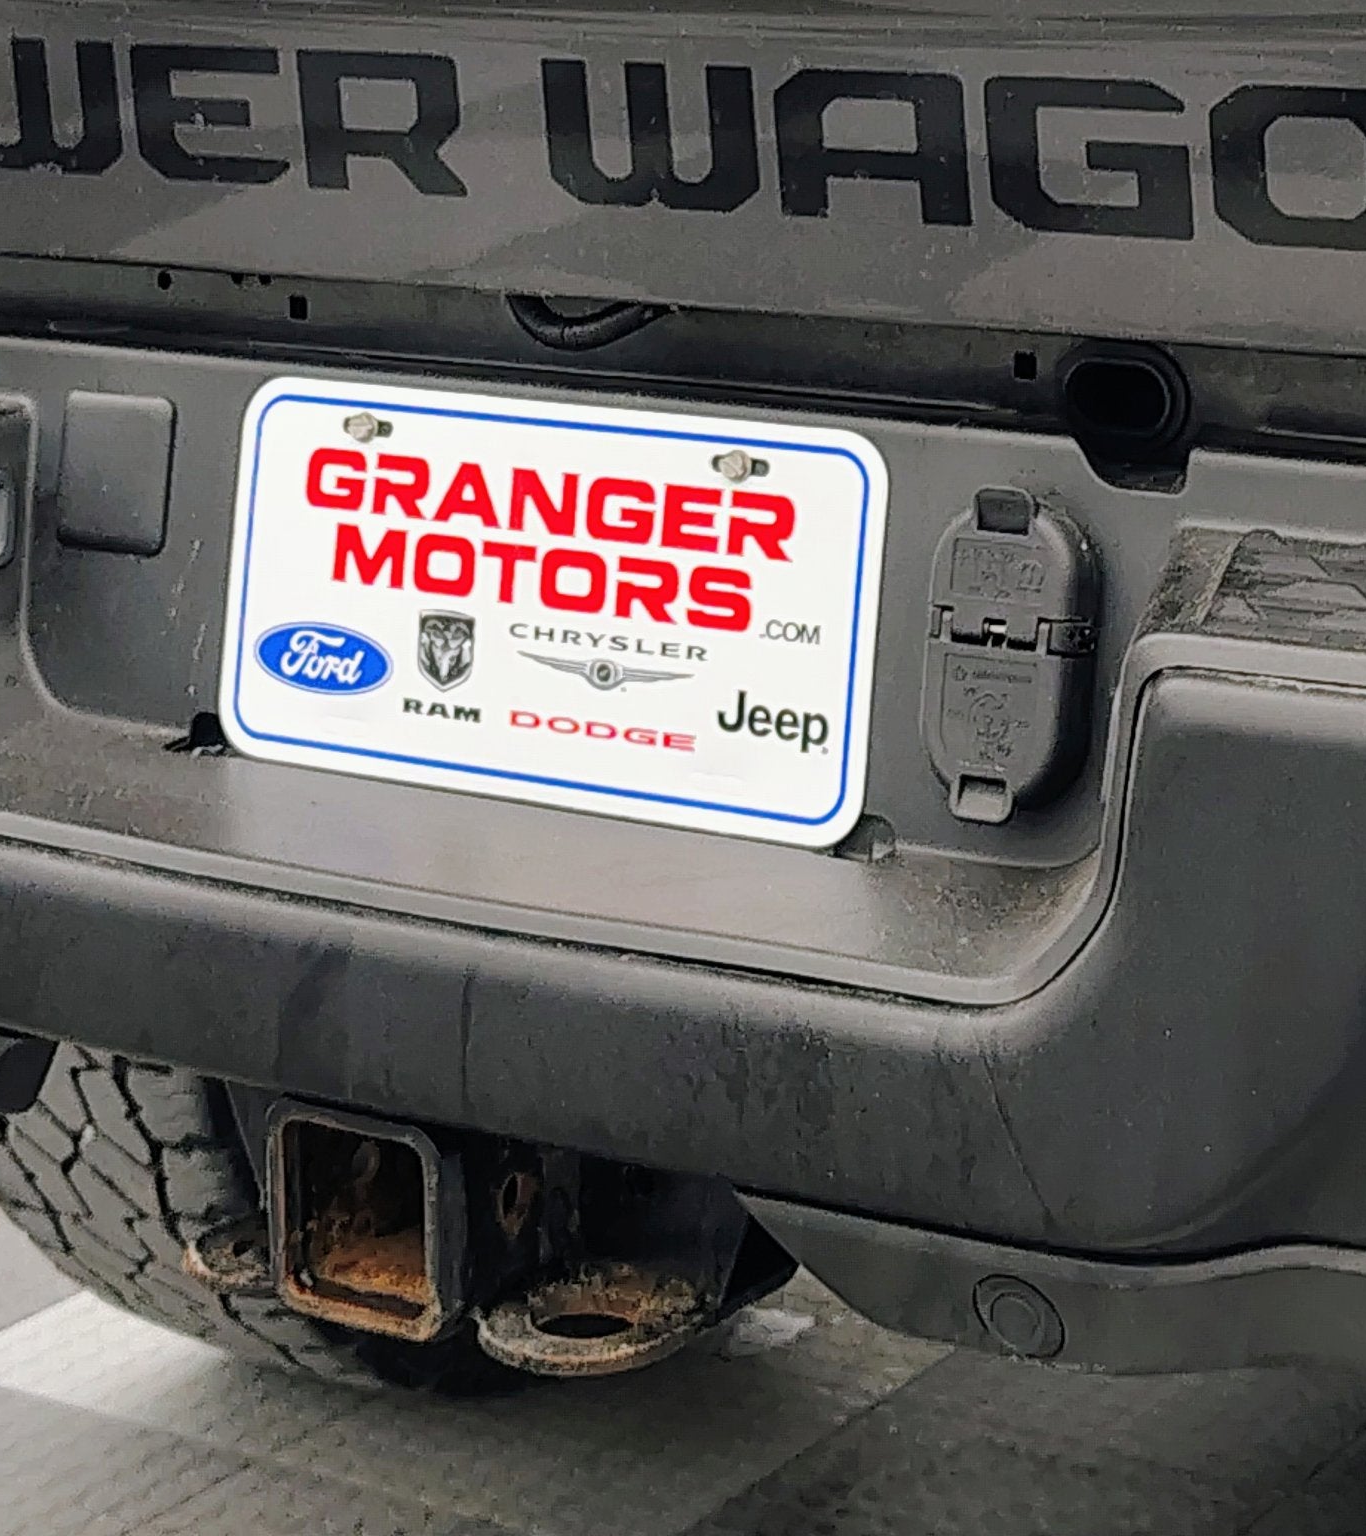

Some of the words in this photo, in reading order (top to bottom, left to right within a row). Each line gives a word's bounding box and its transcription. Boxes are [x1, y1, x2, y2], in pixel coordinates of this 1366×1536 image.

[305, 446, 796, 562] GRANGER
[330, 522, 754, 633] MOTORS
[758, 619, 822, 646] .COM
[280, 629, 366, 686] Ford
[508, 622, 709, 662] CHRYSLER
[402, 696, 483, 724] RAM
[508, 709, 697, 753] DODGE
[716, 689, 830, 754] Jeep
